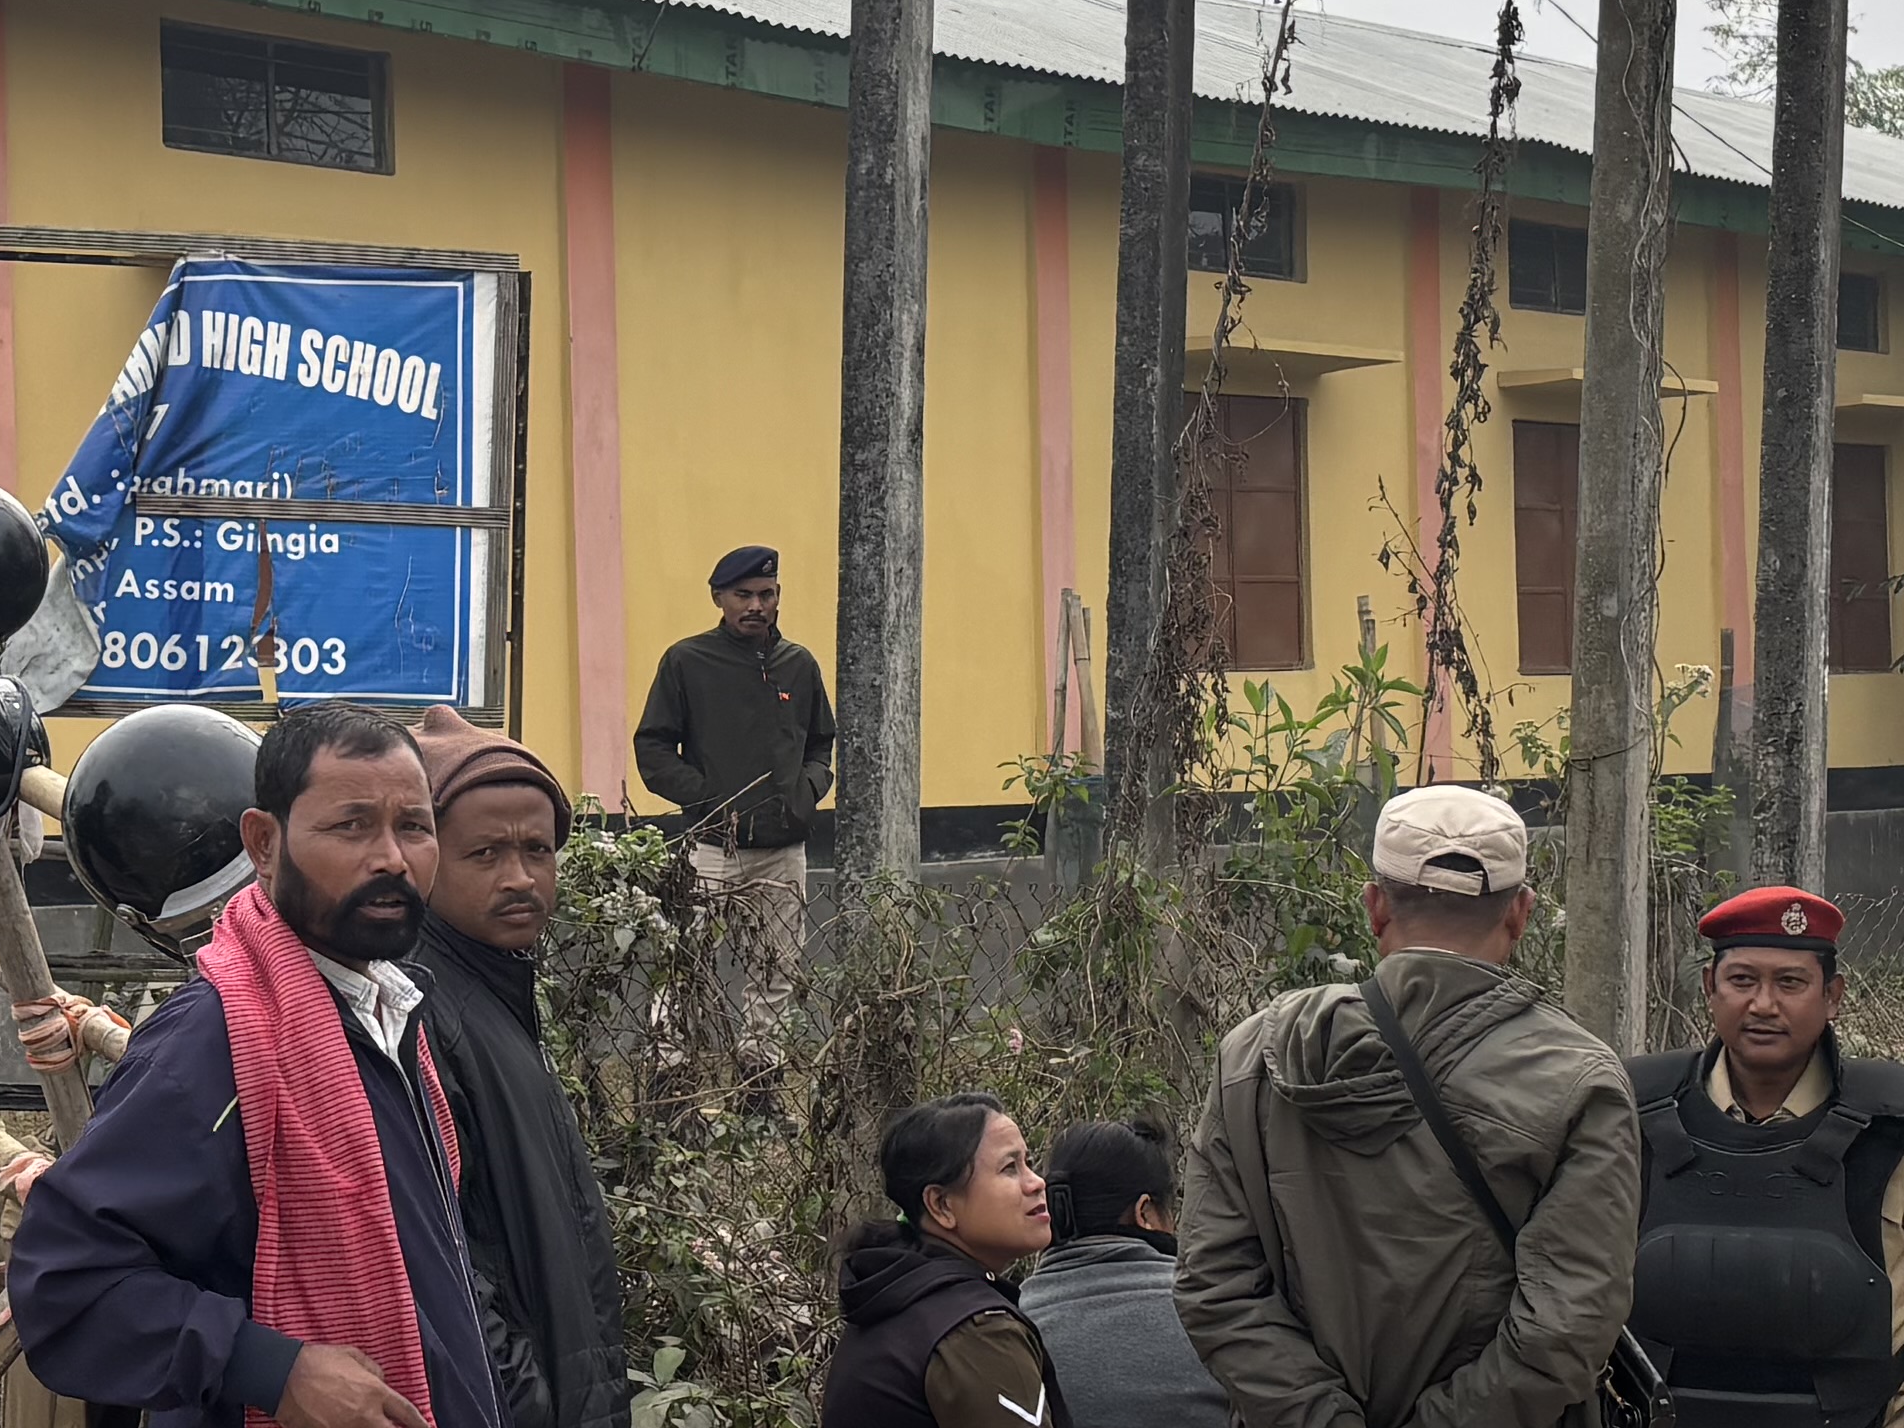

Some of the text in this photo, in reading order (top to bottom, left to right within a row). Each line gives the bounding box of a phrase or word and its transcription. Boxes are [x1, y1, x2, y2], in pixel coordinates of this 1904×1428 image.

[201, 309, 292, 381] HIGH
[297, 328, 443, 420] SCHOOL
[134, 517, 203, 548] P.S.:
[115, 569, 235, 603] Assam
